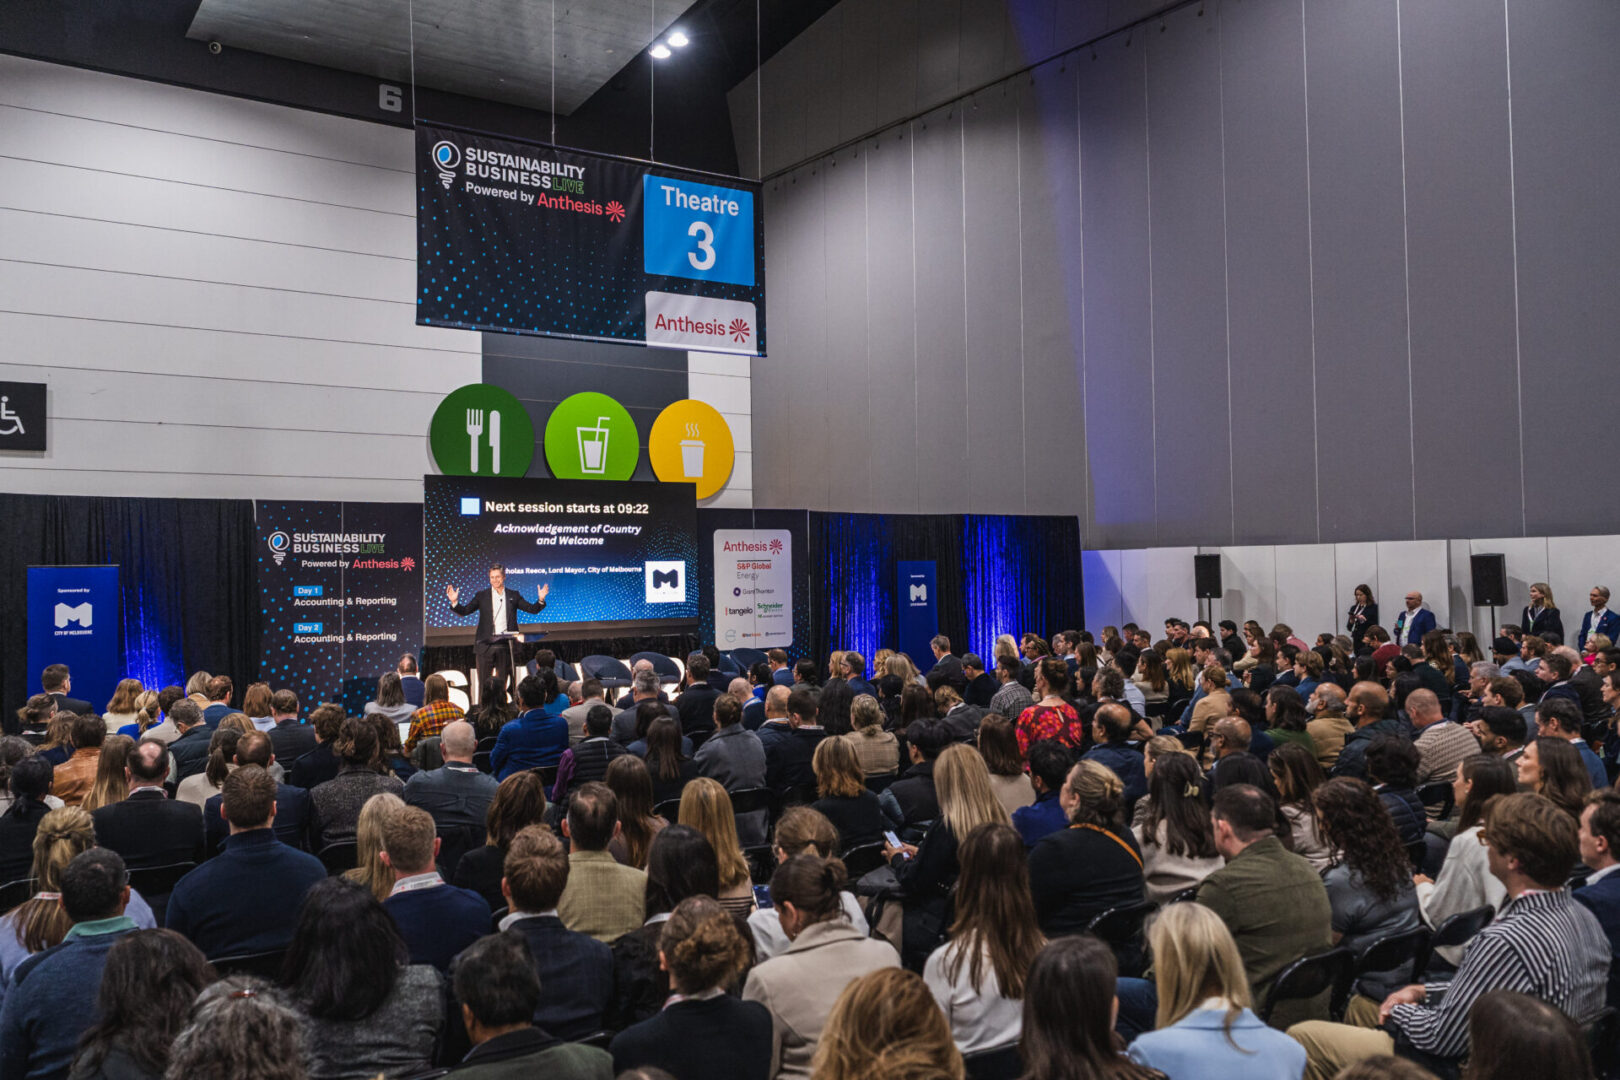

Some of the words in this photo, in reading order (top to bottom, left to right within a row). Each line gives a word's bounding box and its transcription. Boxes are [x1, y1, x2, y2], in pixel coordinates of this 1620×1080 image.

[379, 84, 402, 112] 6
[465, 147, 585, 180] SUSTAINABILITY
[465, 181, 517, 200] Powered
[520, 190, 534, 206] by
[537, 192, 603, 216] Anthesis
[660, 185, 739, 217] Theatre
[687, 220, 717, 271] 3
[654, 313, 726, 336] Anthesis
[485, 501, 515, 512] Next
[518, 501, 564, 513] session
[566, 503, 600, 513] starts
[603, 504, 615, 514] at
[617, 503, 649, 514] 09:22
[494, 523, 589, 535] Acknowledgement
[590, 524, 602, 533] of
[603, 524, 642, 535] Country
[293, 533, 386, 543] SUSTAINABILITY
[536, 536, 557, 545] and
[558, 536, 604, 545] Welcome
[723, 541, 768, 552] Anthesis
[302, 559, 338, 568] Powered
[339, 559, 350, 569] by
[352, 558, 399, 569] Anthesis
[751, 562, 772, 570] Global
[587, 566, 600, 574] City
[297, 587, 313, 595] Day
[294, 598, 345, 607] Accounting
[355, 597, 397, 606] Reporting
[728, 606, 754, 616] tangelo
[297, 624, 313, 632] Day
[294, 634, 345, 643] Accounting
[346, 634, 353, 642] &
[355, 633, 397, 642] Reporting
